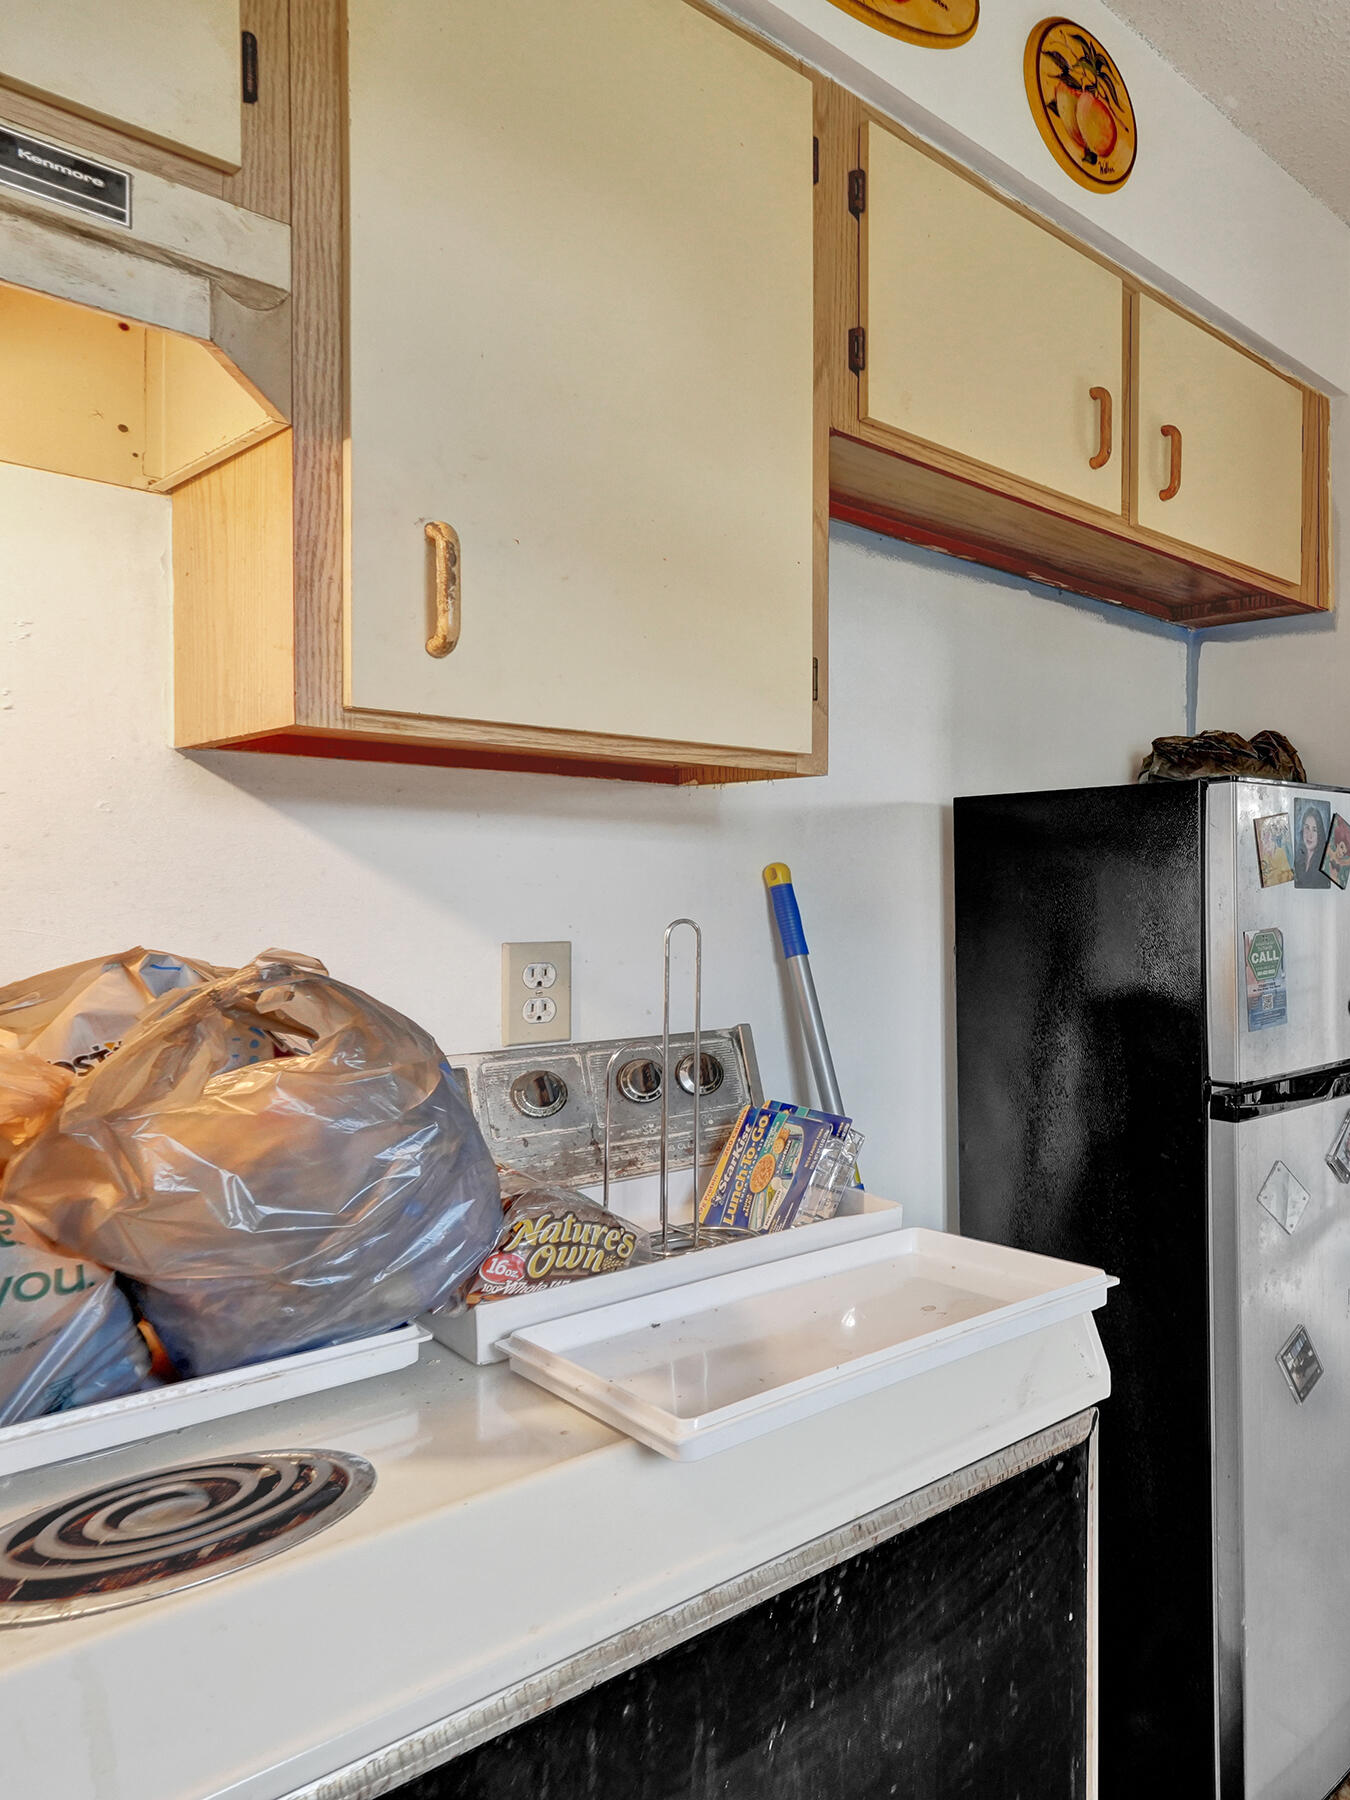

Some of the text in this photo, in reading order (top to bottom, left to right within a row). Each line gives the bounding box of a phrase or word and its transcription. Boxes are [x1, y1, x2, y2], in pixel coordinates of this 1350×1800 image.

[17, 147, 106, 188] Kenmore
[1251, 950, 1279, 965] CALL
[717, 1122, 752, 1194] StarKist
[503, 1212, 636, 1258] Nature's
[527, 1244, 605, 1279] Own
